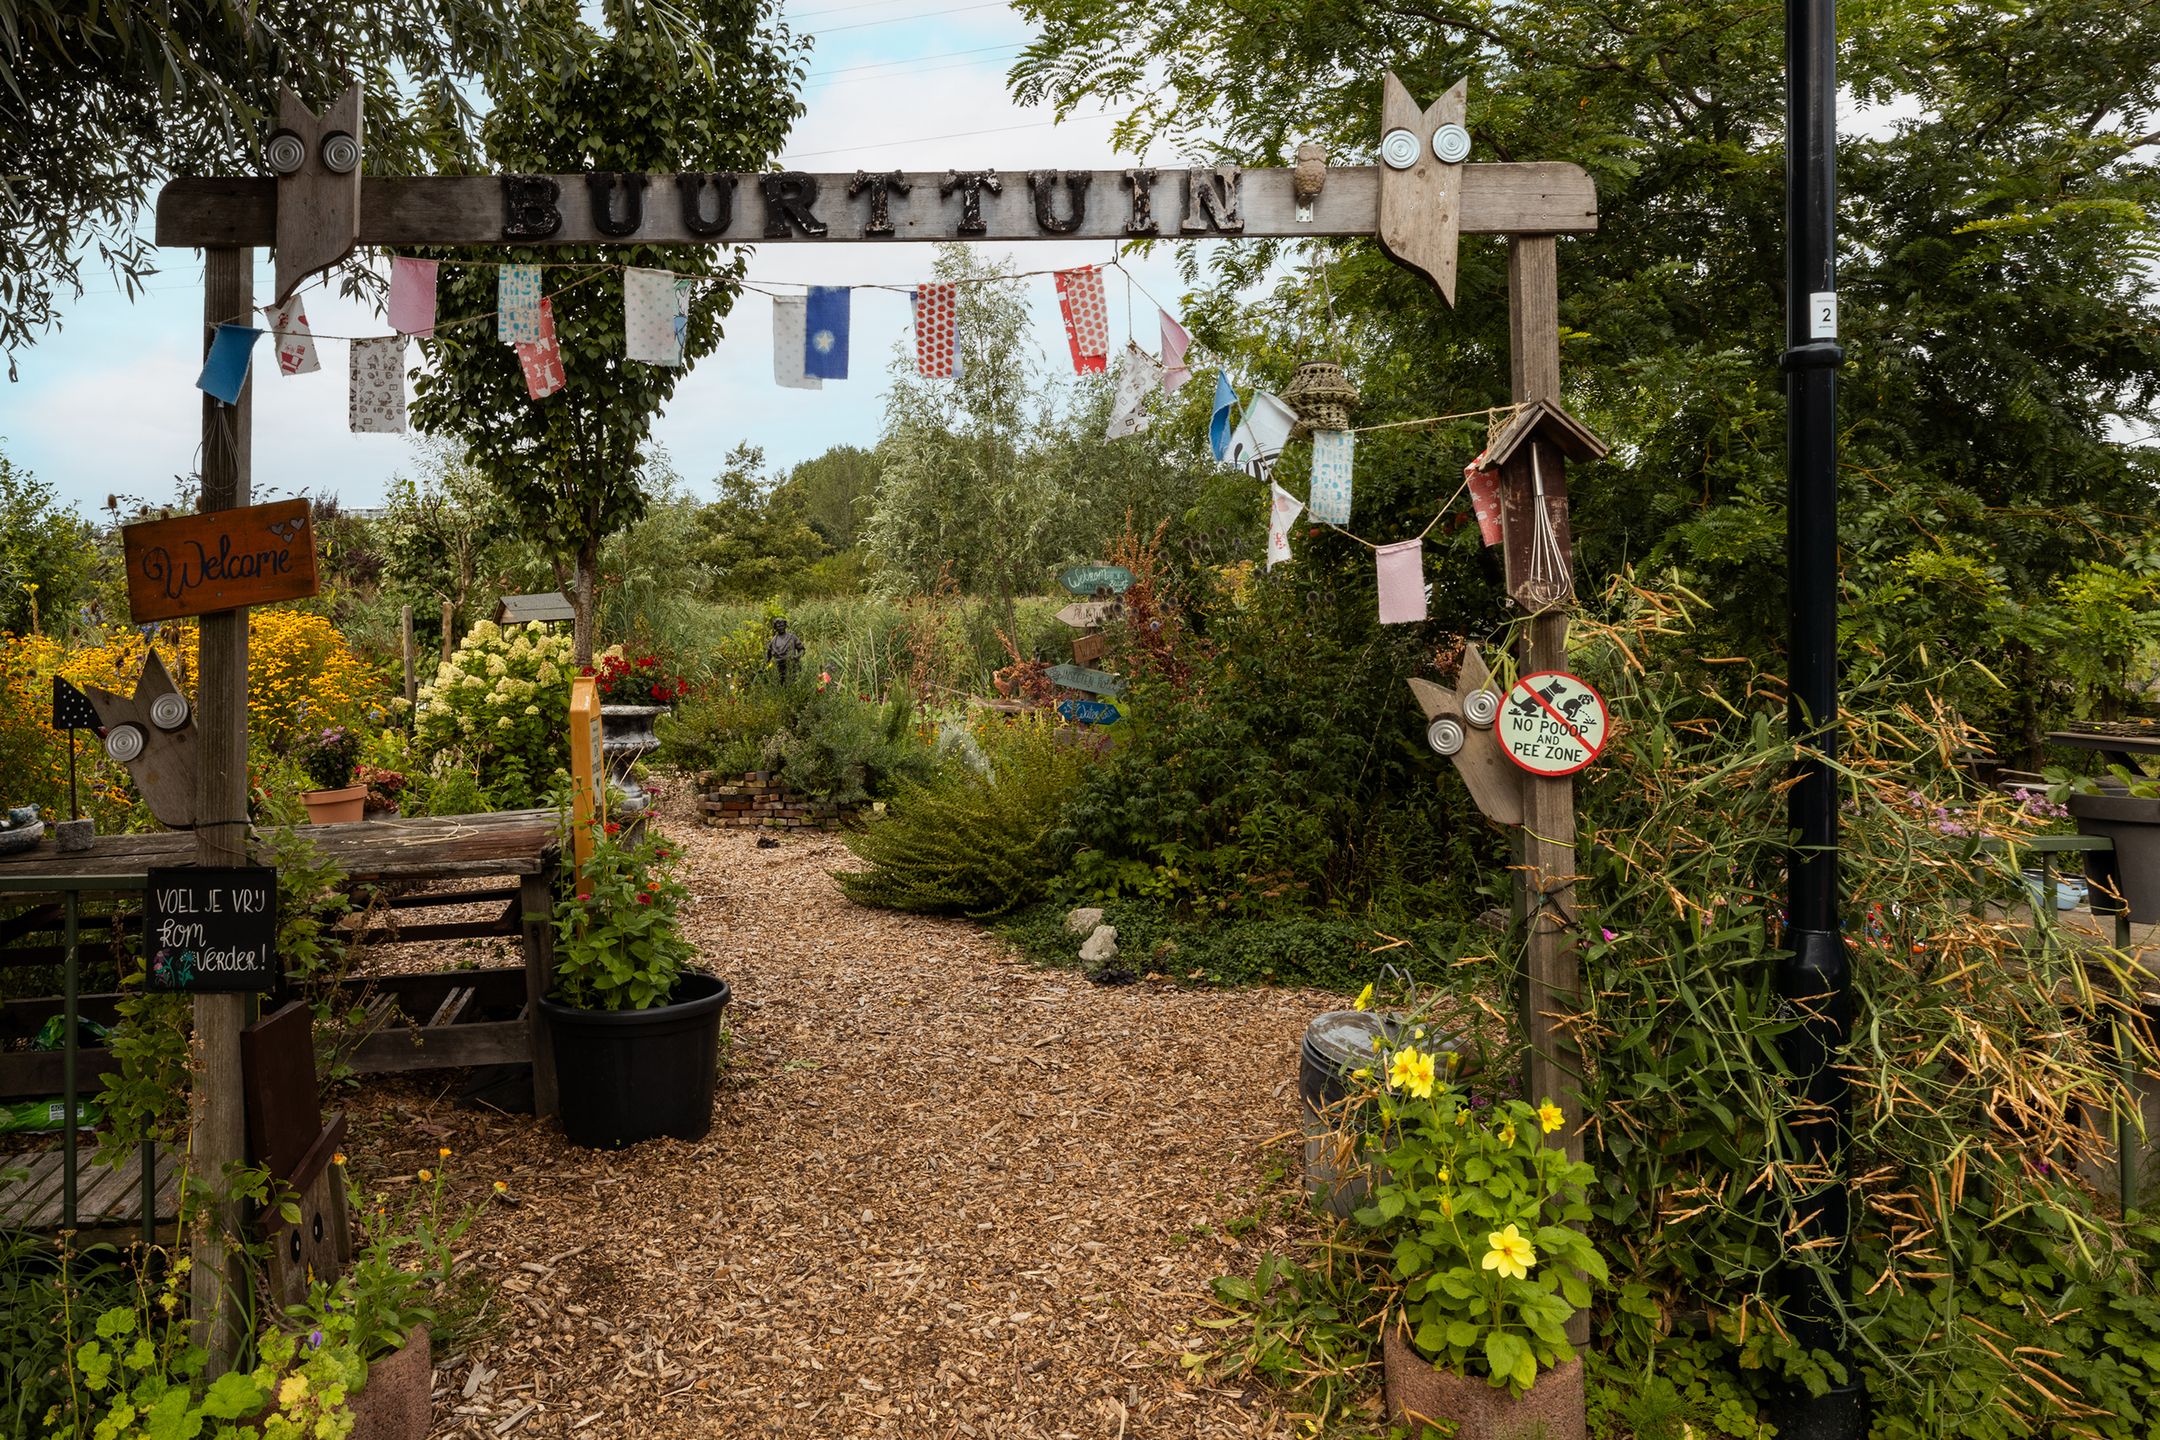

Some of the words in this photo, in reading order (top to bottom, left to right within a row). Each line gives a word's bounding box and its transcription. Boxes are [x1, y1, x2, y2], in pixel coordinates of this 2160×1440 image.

[501, 168, 1245, 239] BUURTTUIN
[1822, 307, 1831, 322] 2
[142, 534, 292, 599] Welcome
[1512, 717, 1533, 732] NO
[1540, 720, 1589, 738] POOOP
[1537, 734, 1560, 746] AND
[1513, 742, 1540, 758] PEE
[1544, 745, 1583, 763] ZONE
[157, 888, 199, 914] VOEL
[204, 889, 223, 913] JE
